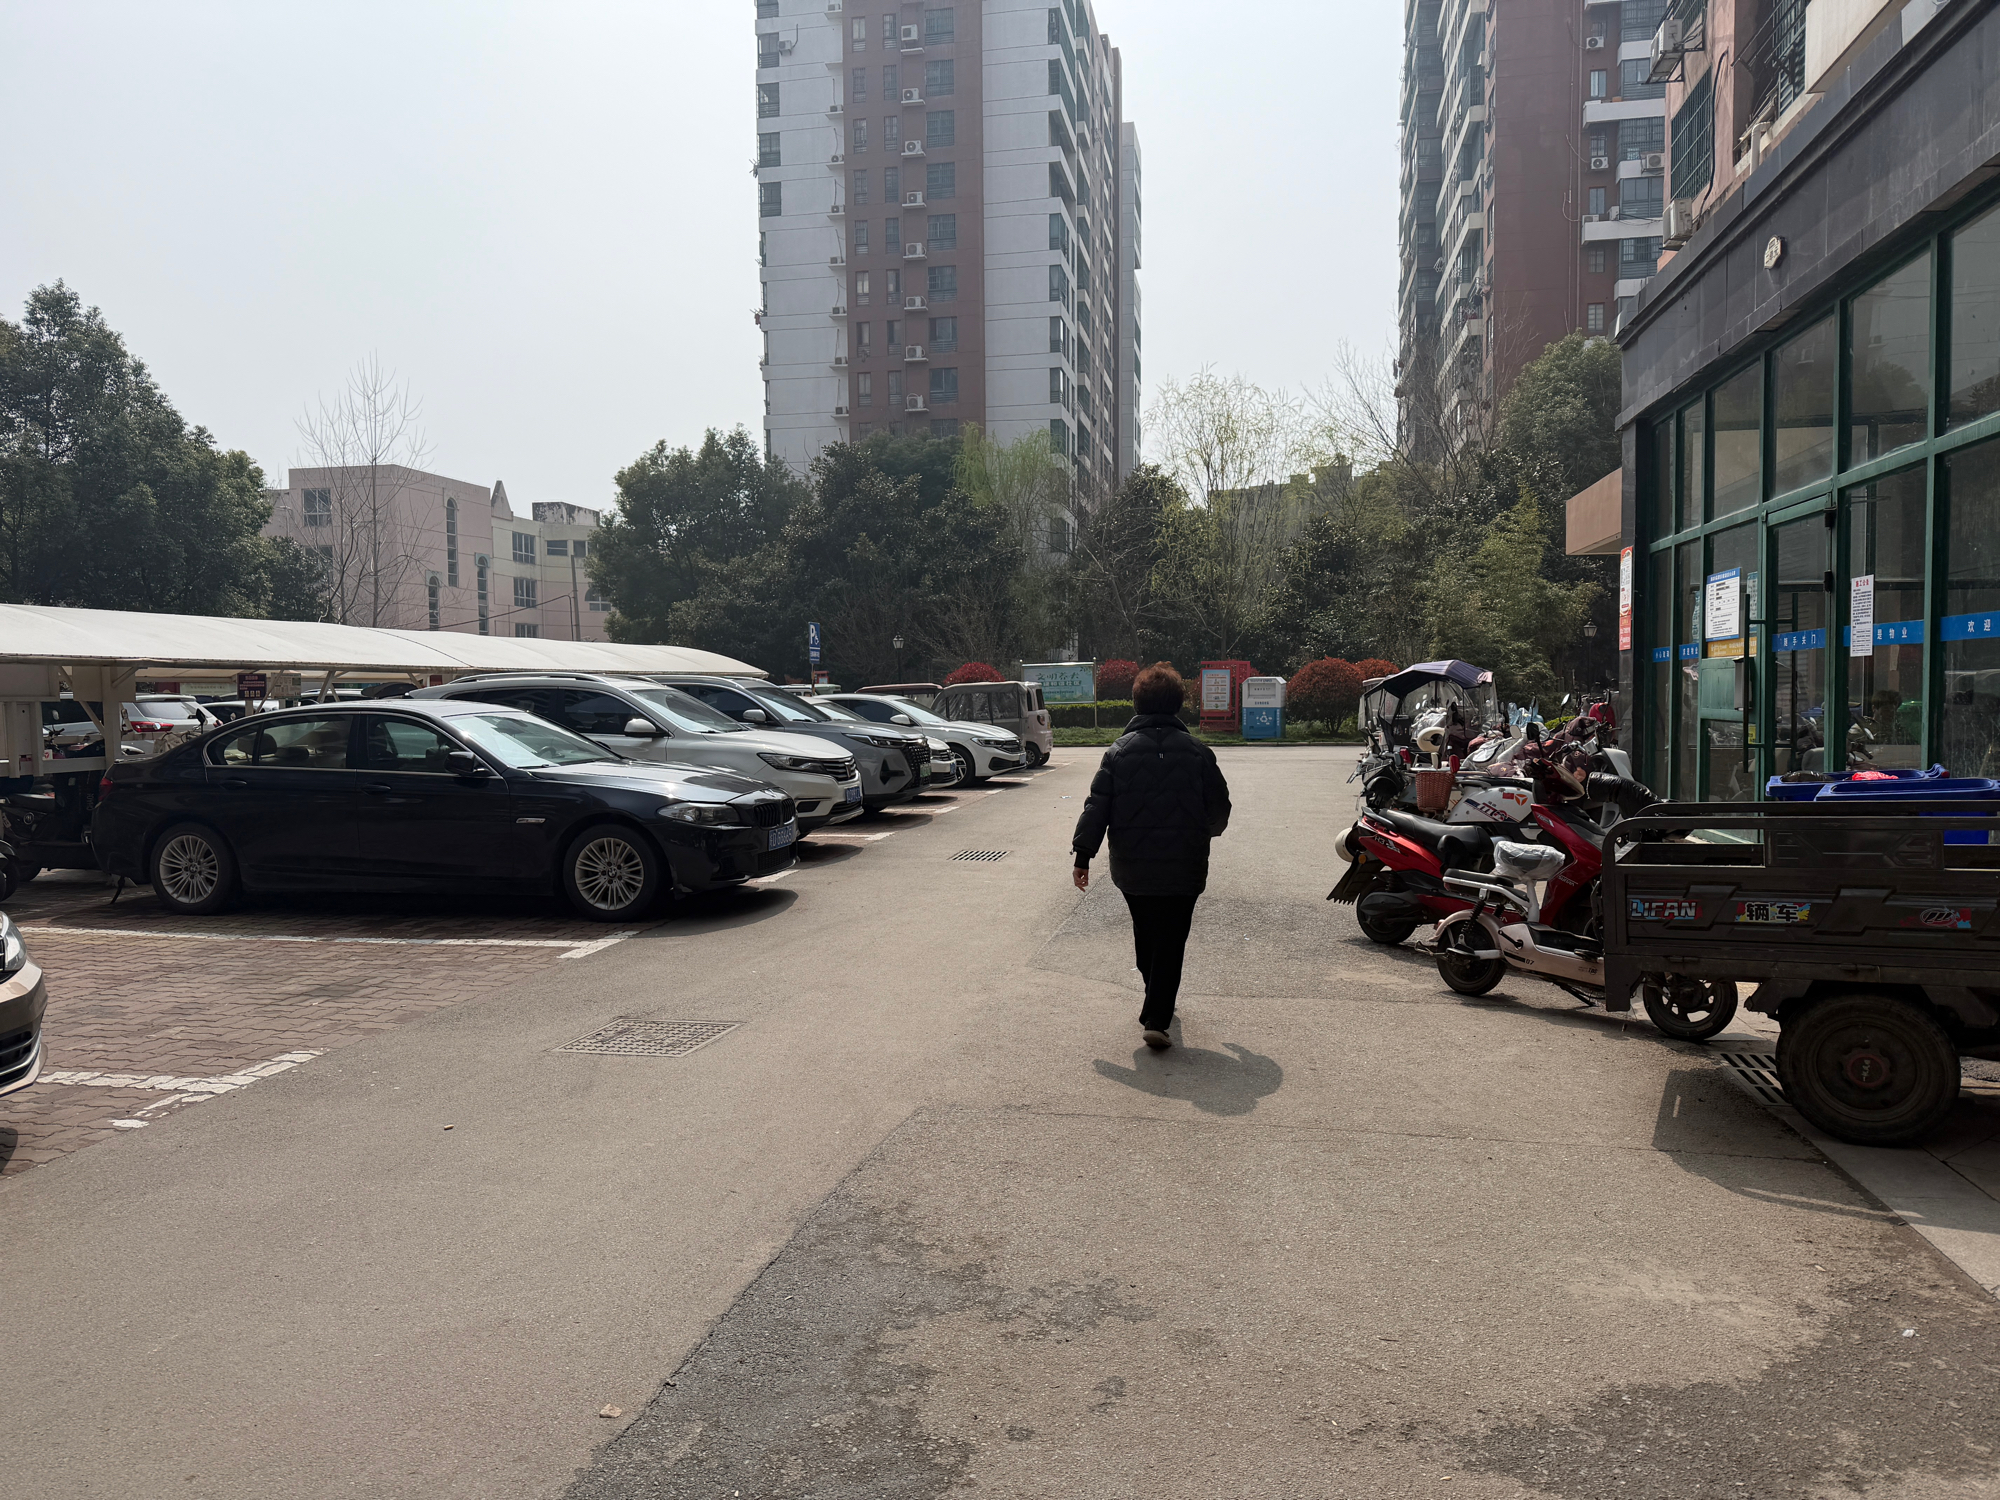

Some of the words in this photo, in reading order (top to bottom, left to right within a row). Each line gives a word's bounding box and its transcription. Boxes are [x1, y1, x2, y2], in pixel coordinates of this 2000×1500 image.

[1877, 627, 1908, 640] 是物业
[1967, 619, 1991, 633] 欢迎
[810, 624, 816, 645] P
[1783, 633, 1816, 647] 随手关门
[1631, 901, 1697, 917] LIFAN
[1746, 902, 1798, 922] 辆车
